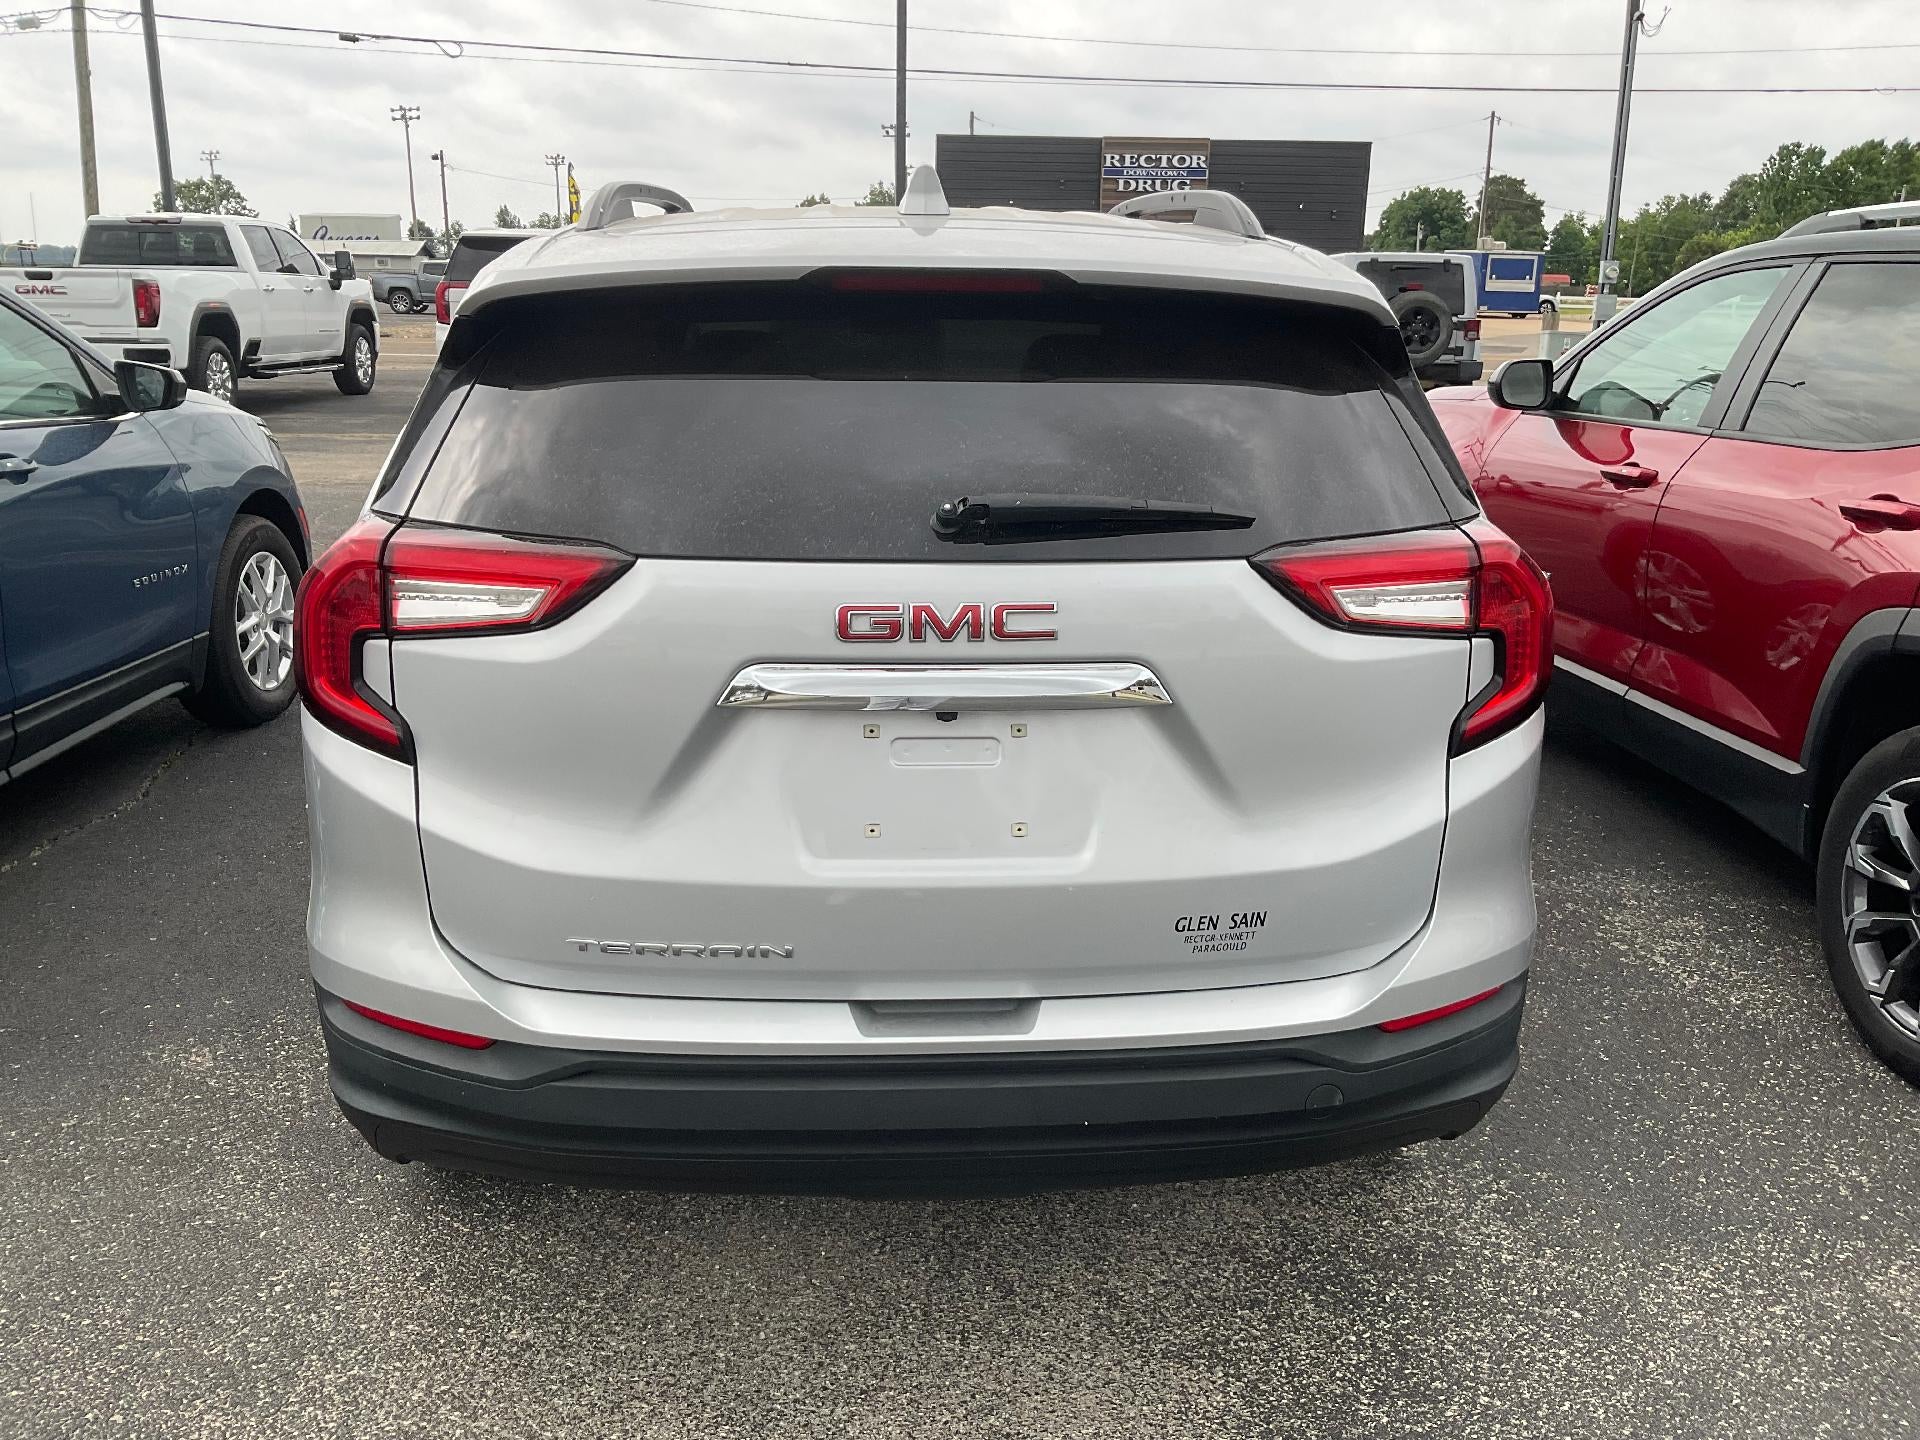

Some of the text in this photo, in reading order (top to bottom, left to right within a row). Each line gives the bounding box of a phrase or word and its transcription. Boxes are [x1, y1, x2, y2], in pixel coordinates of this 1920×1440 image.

[1103, 153, 1208, 169] RECTOR
[1123, 169, 1188, 177] DOWNTOWN
[1116, 178, 1191, 192] DRUG
[14, 284, 68, 296] GMC
[133, 563, 188, 588] EQUINOX
[835, 601, 1058, 642] GMC
[1174, 910, 1268, 933] GLEN SAIN
[565, 937, 794, 959] TERRAIN
[1192, 942, 1247, 954] PARAGOULD
